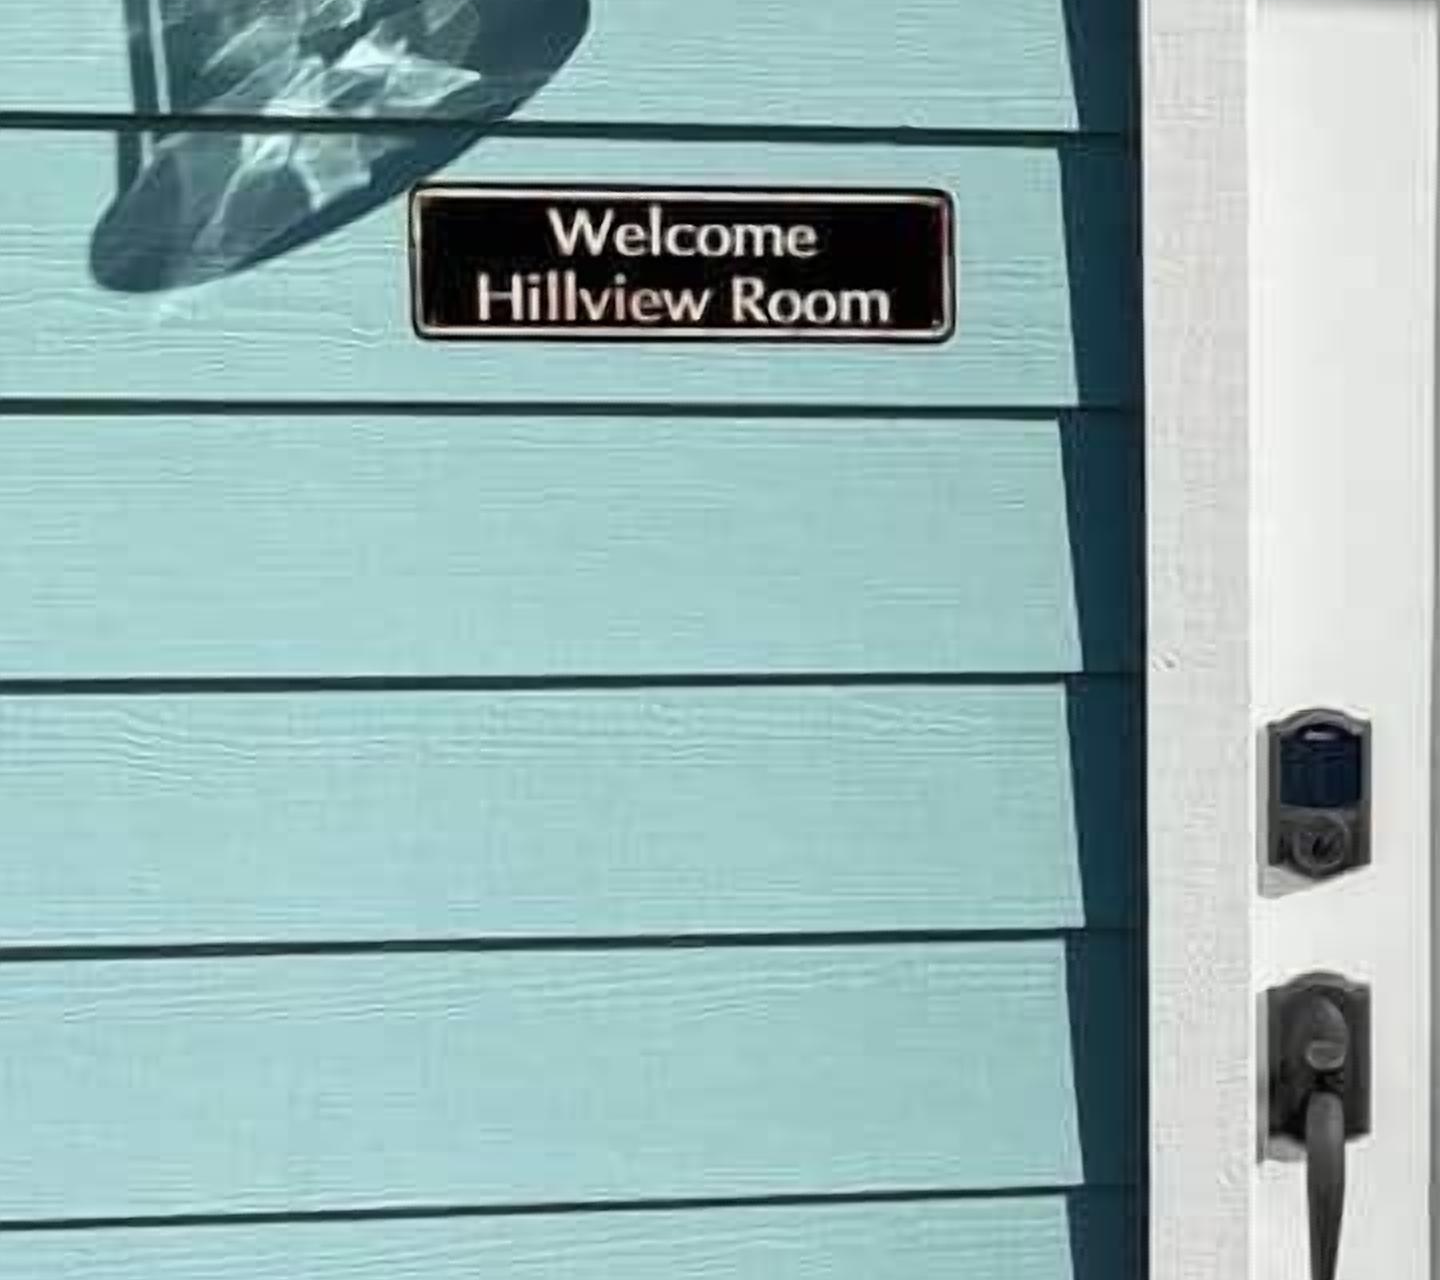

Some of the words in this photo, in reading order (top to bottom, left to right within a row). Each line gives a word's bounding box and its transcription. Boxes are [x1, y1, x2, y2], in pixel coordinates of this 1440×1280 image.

[548, 206, 816, 257] Welcome
[478, 271, 710, 321] Hillview
[732, 277, 889, 323] Room
